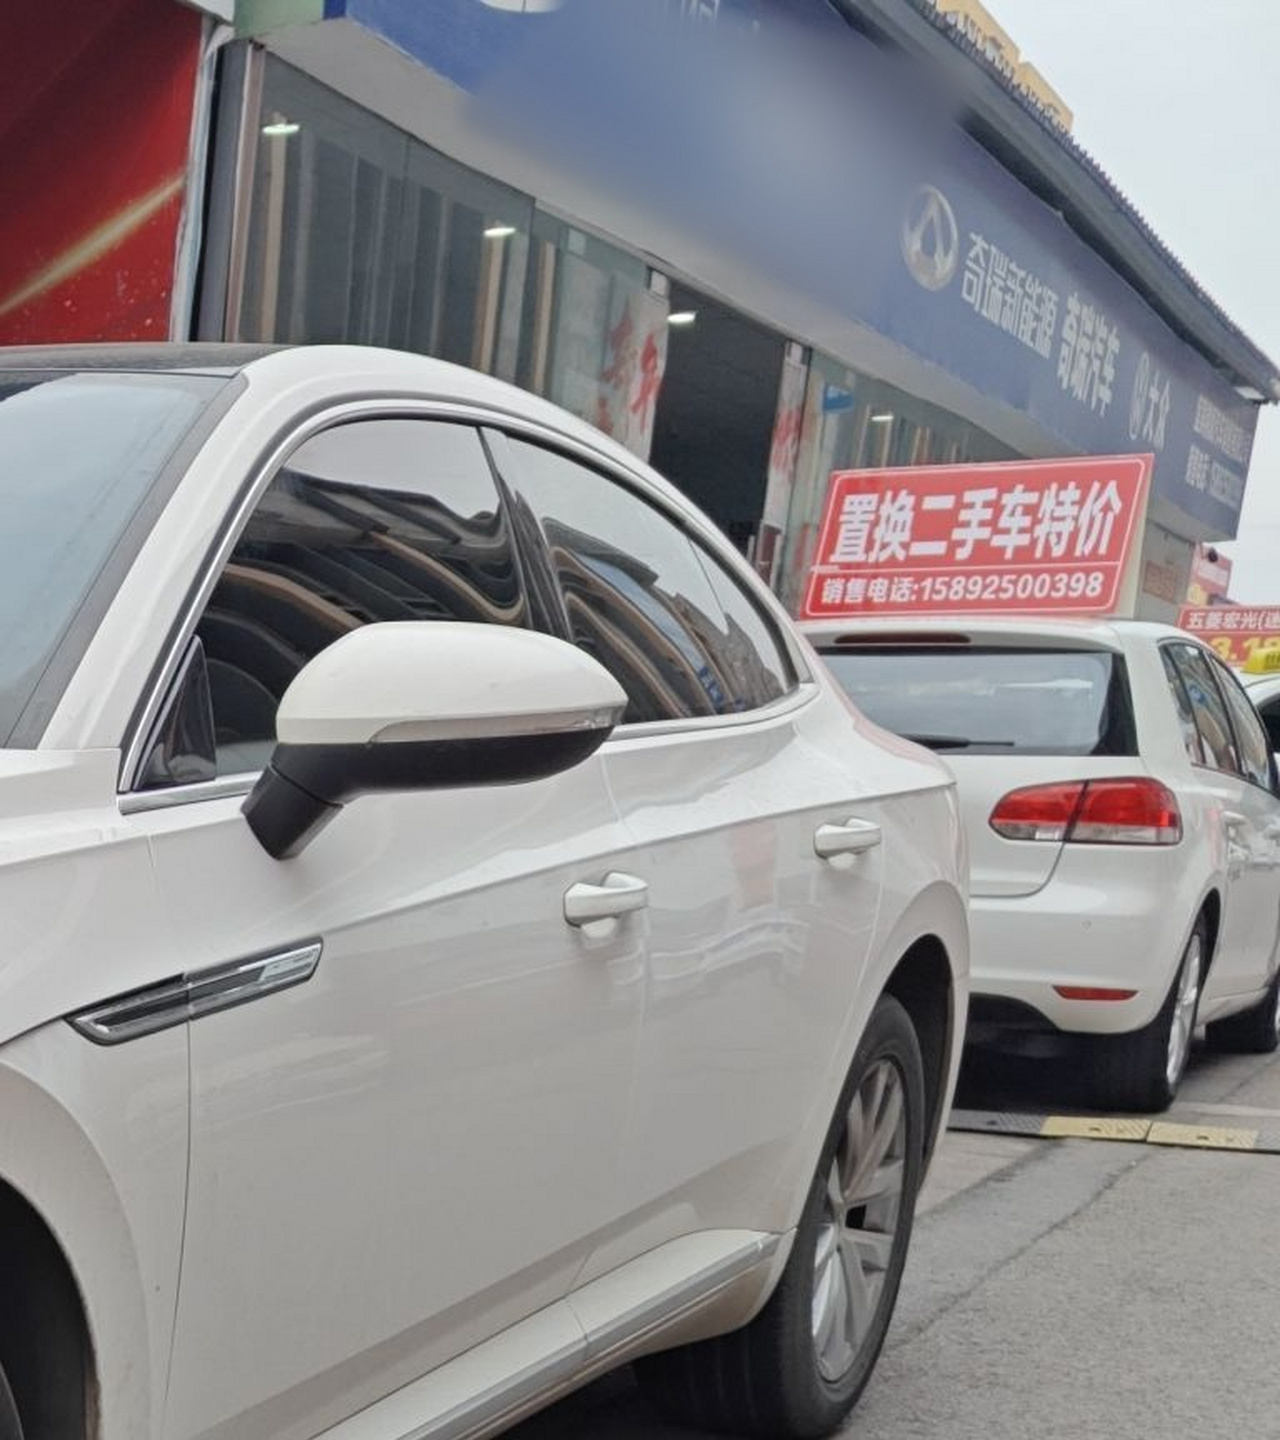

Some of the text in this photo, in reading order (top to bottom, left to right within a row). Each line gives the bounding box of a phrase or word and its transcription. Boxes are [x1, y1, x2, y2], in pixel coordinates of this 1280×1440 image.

[962, 233, 1058, 359] 奇瑞新能源
[1057, 293, 1121, 416] 奇瑞汽车
[829, 480, 1122, 563] 置换二手车特价
[821, 571, 1104, 604] 销售电话:15892500398
